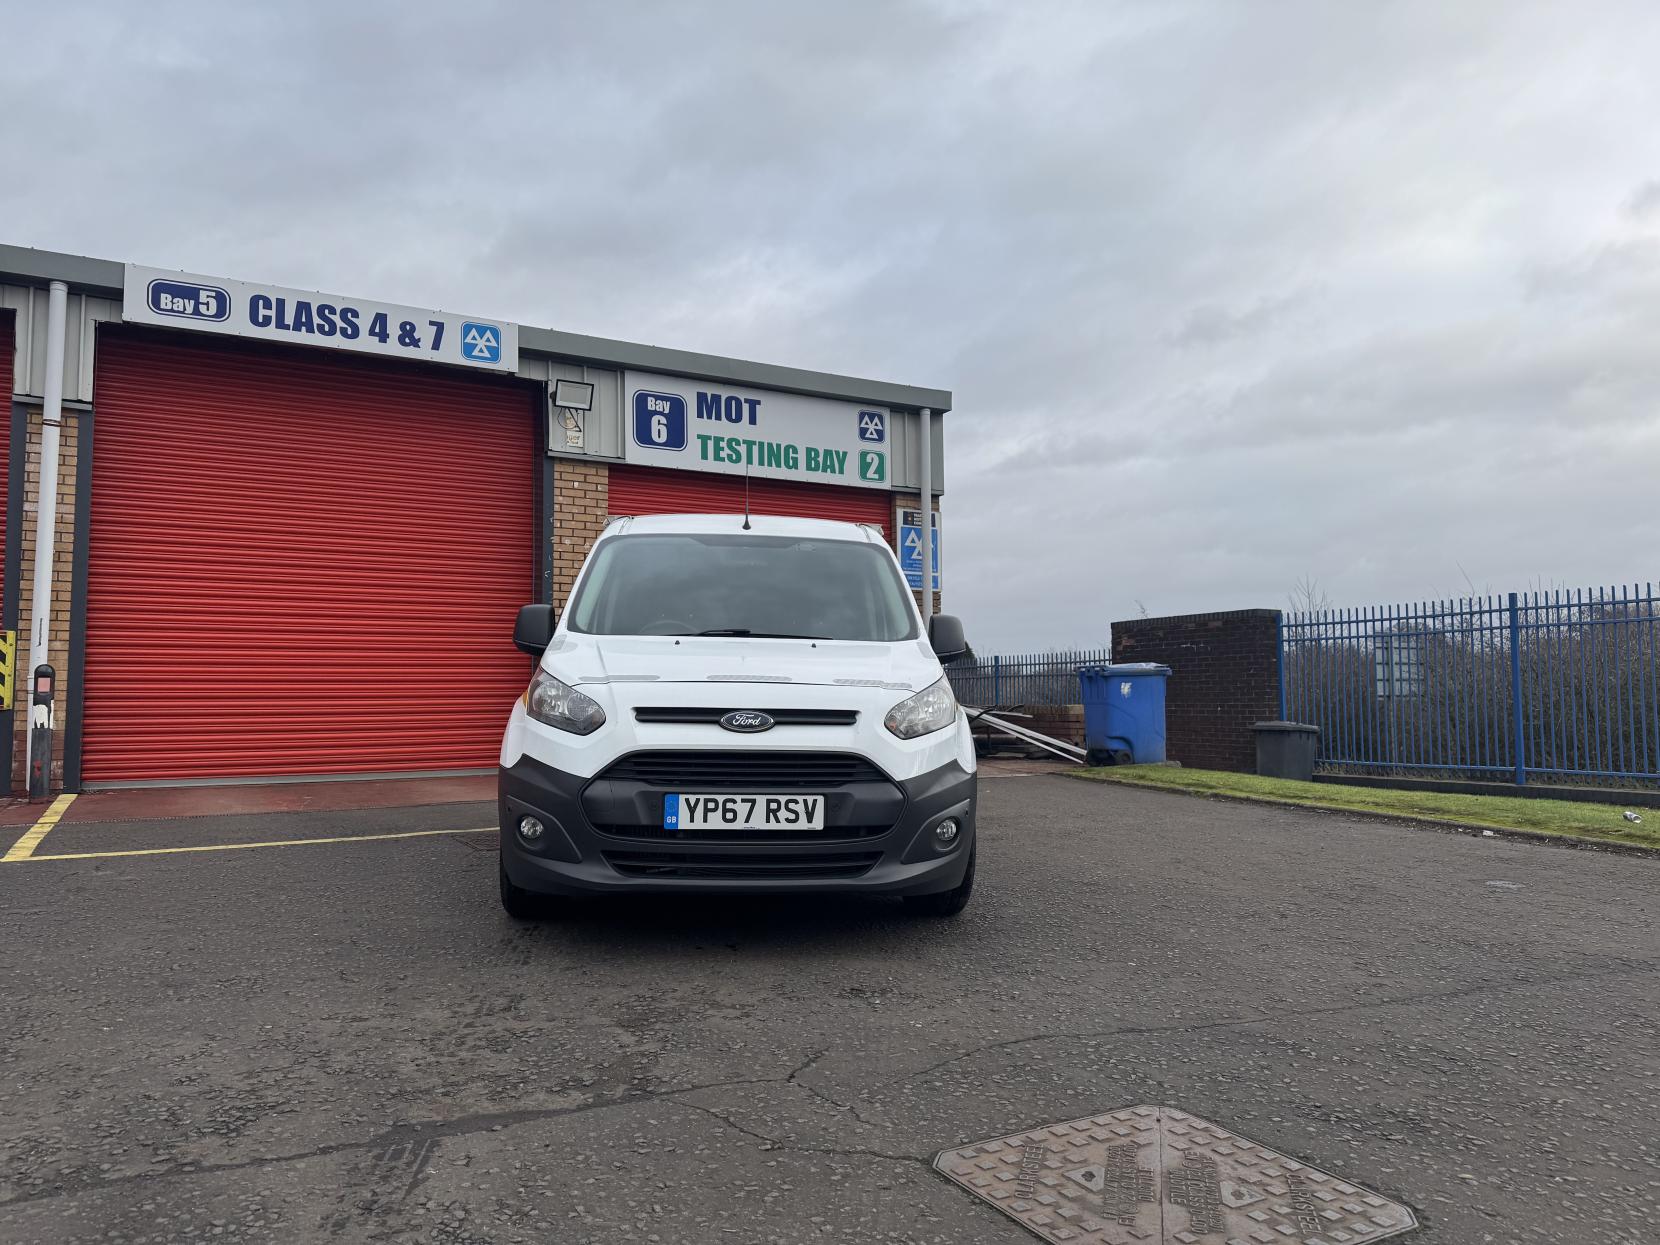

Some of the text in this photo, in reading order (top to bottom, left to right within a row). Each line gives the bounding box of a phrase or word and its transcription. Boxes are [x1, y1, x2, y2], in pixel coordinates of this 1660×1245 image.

[160, 290, 217, 316] Bay 5
[249, 294, 445, 351] CLASS 4 & 7
[647, 397, 671, 414] Bay
[696, 392, 761, 426] MOT
[651, 415, 668, 444] 6
[696, 434, 848, 475] TESTING BAY
[866, 453, 879, 479] 2
[732, 713, 762, 726] Ford
[666, 816, 677, 824] GB
[684, 798, 818, 824] YP67 RSV
